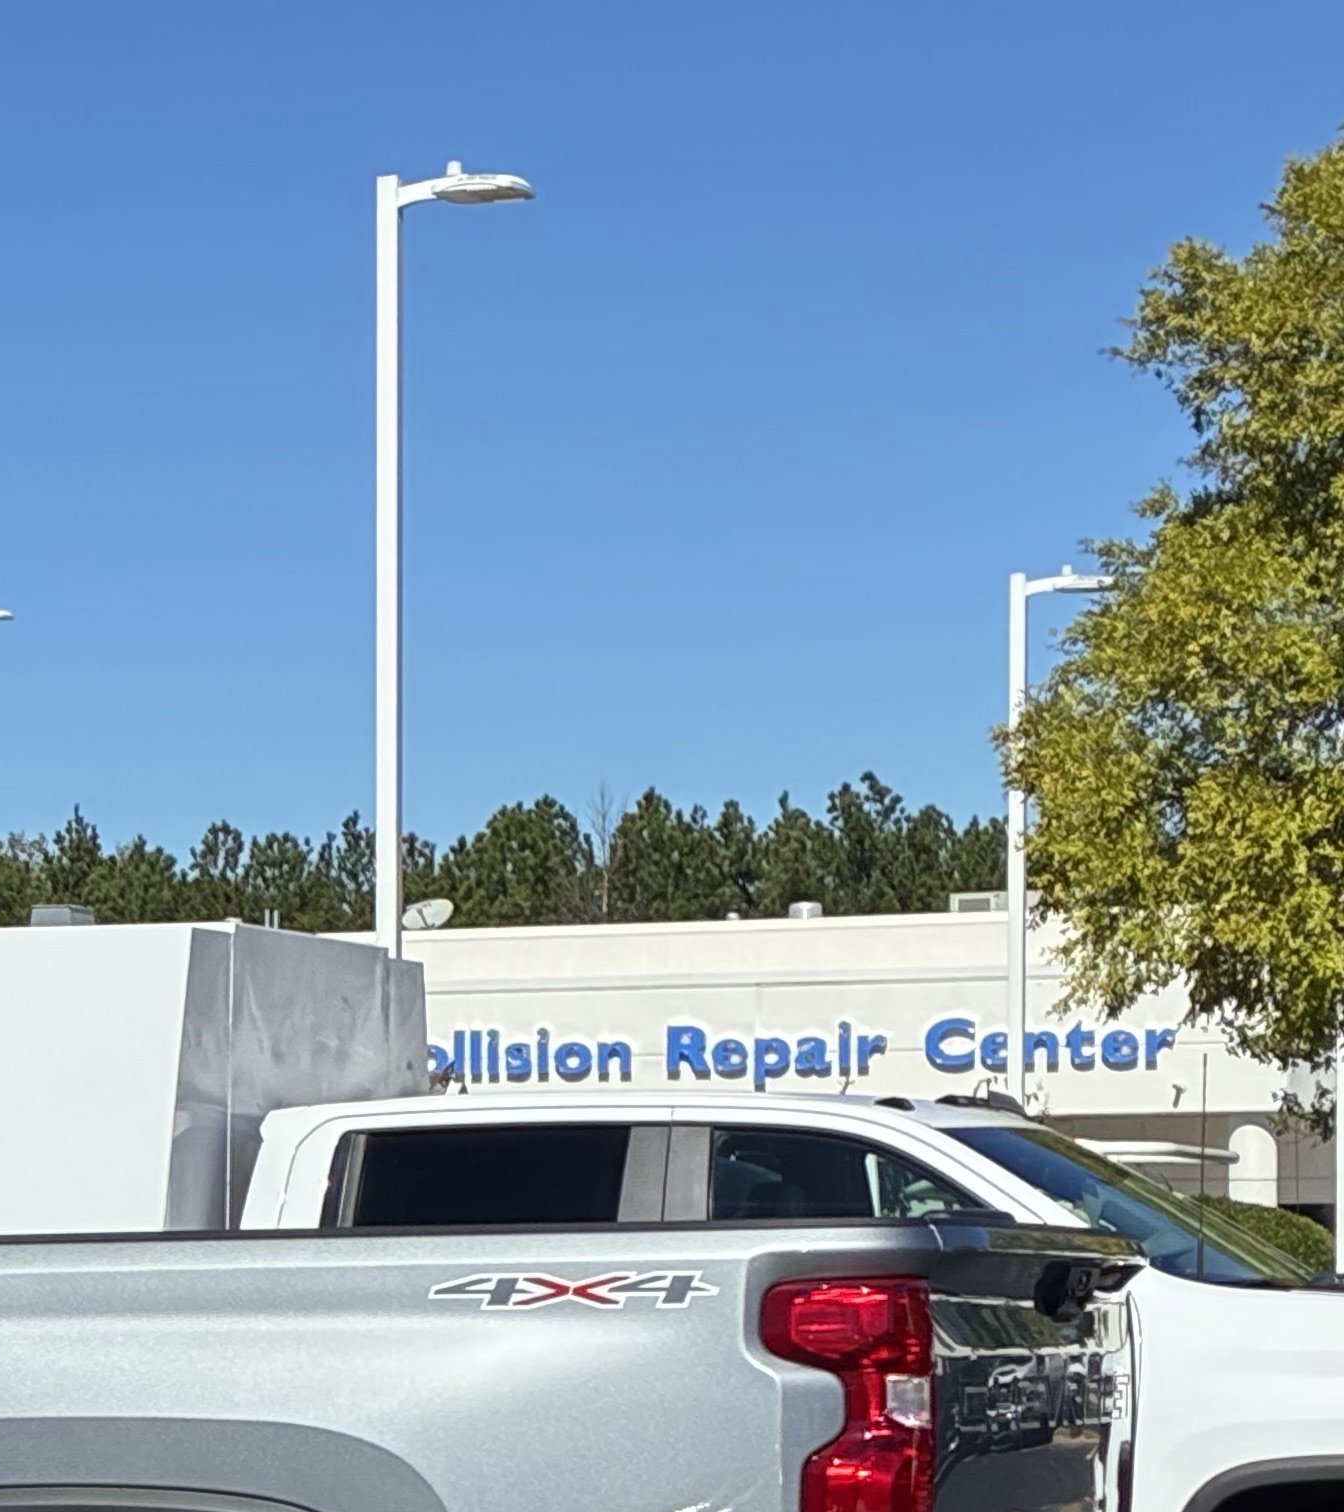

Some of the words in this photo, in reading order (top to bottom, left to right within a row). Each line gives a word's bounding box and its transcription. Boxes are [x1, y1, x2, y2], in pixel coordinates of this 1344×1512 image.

[427, 1027, 633, 1083] ollision
[666, 1020, 888, 1093] Repair
[924, 1017, 1178, 1074] Center
